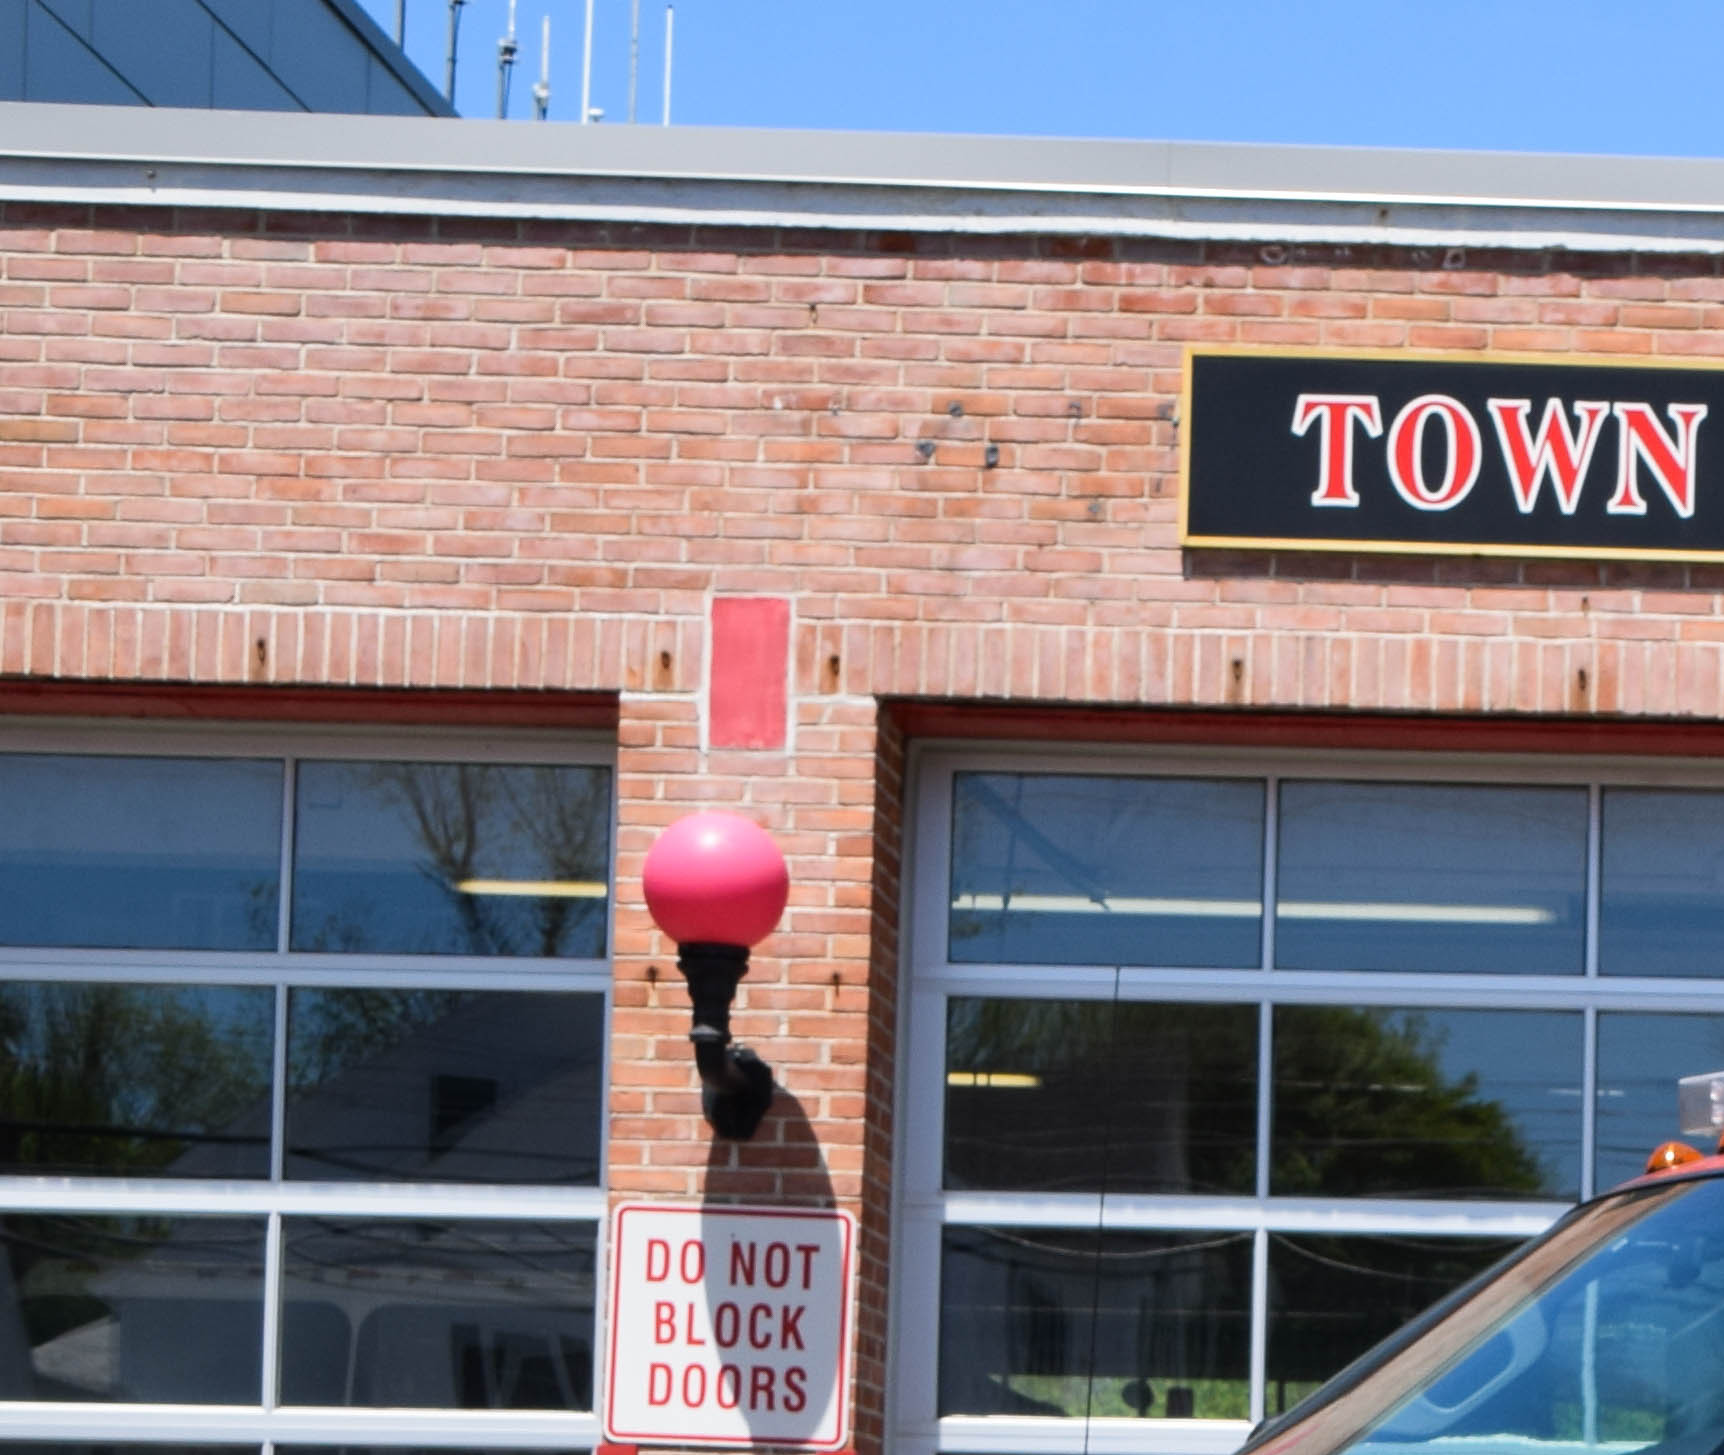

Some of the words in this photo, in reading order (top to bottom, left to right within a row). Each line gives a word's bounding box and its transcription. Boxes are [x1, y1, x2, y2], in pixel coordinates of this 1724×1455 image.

[1292, 394, 1707, 518] TOWN
[646, 1238, 706, 1284] DO
[729, 1240, 821, 1291] NOT
[654, 1301, 807, 1351] BLOCK
[647, 1362, 808, 1413] DOORS
